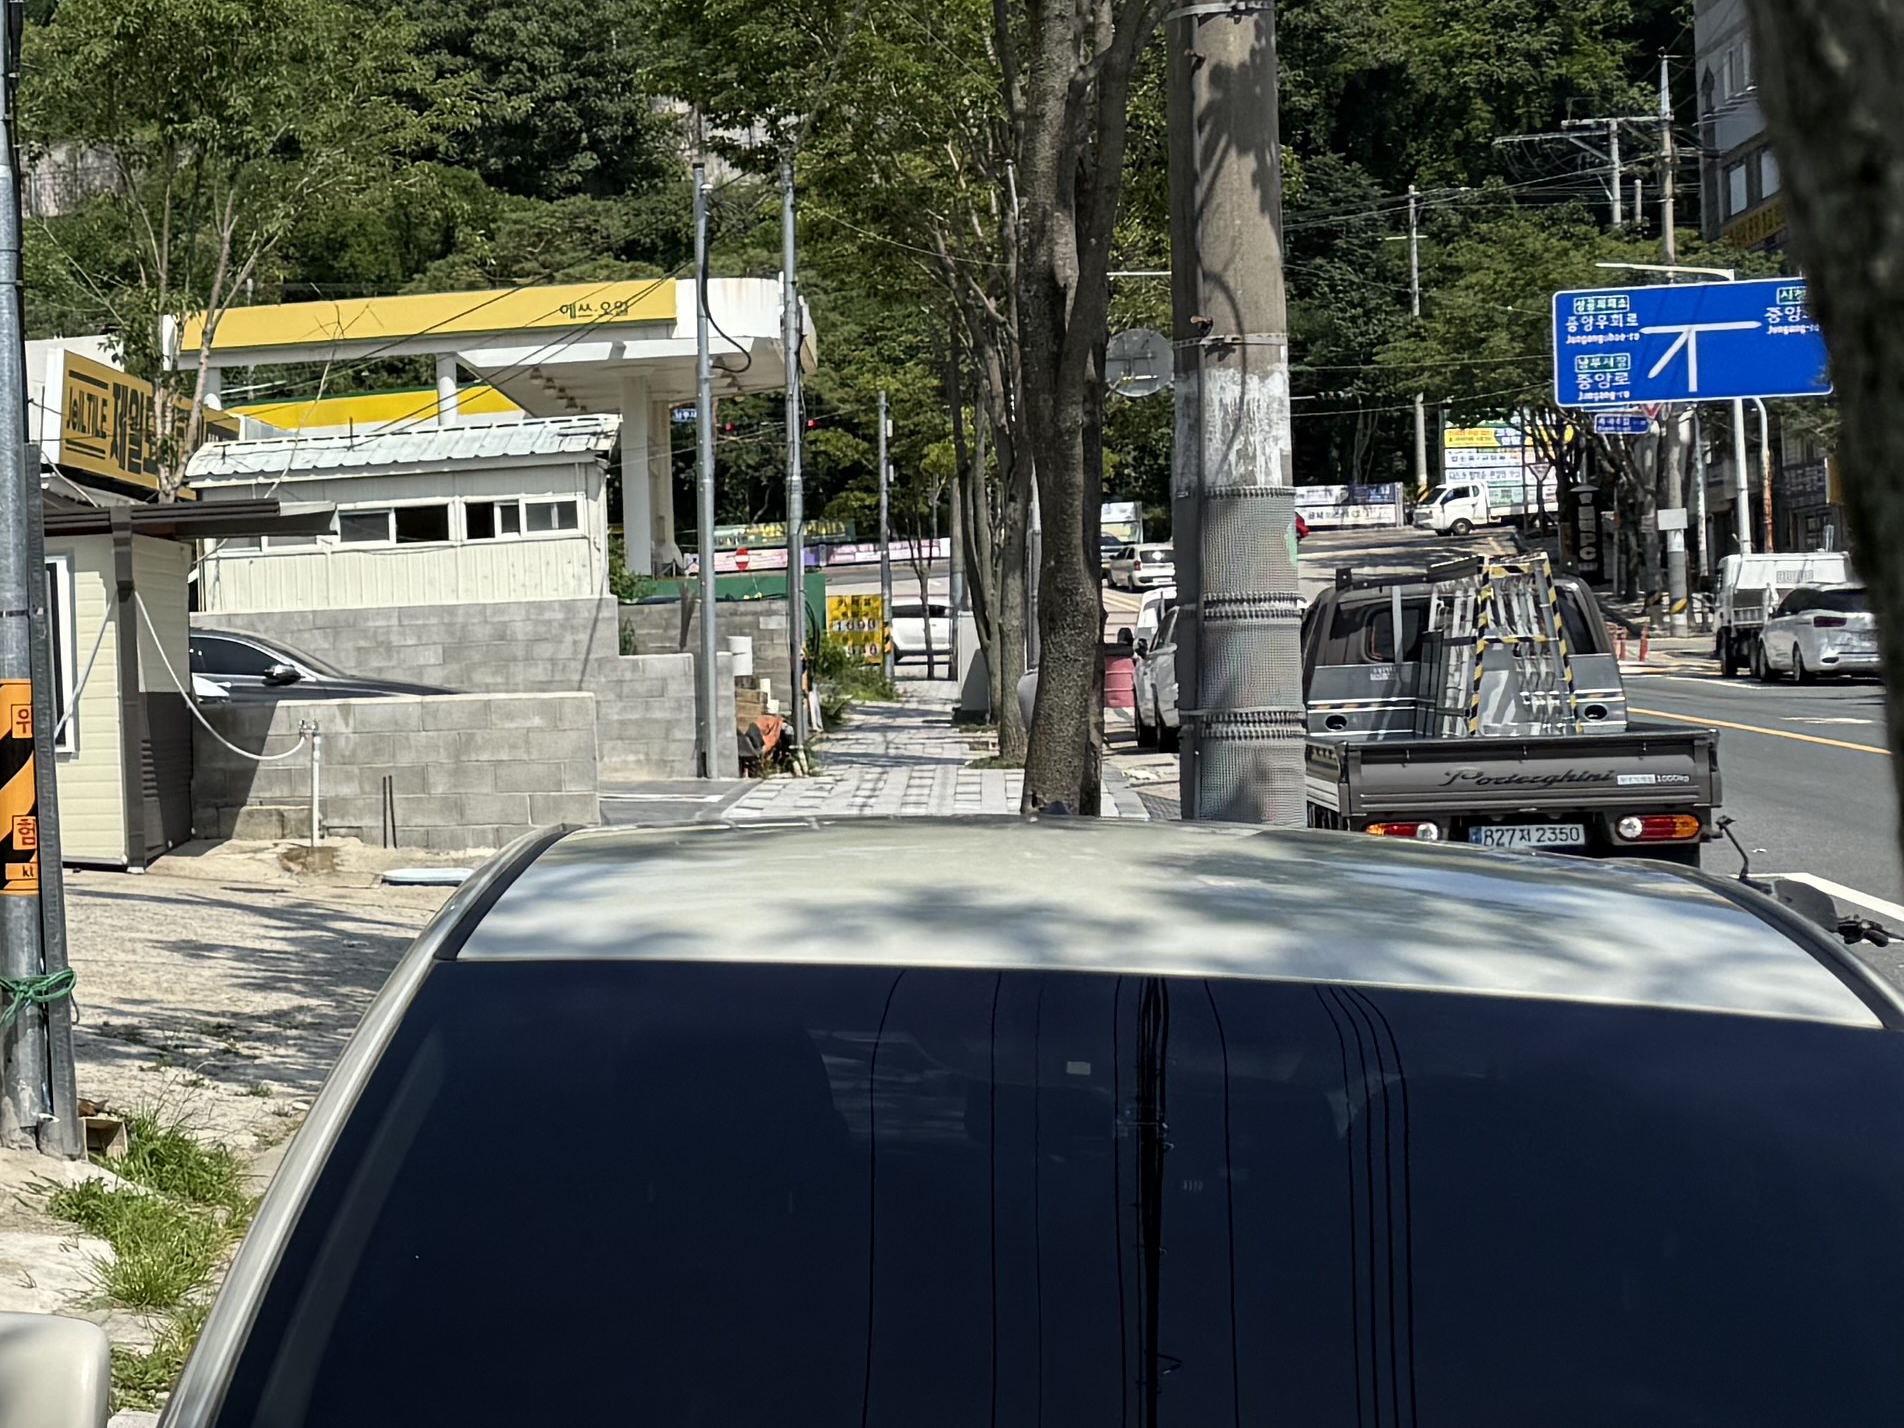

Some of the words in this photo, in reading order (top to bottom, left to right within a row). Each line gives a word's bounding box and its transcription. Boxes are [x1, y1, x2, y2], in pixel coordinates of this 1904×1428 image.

[1566, 313, 1638, 332] 중앙우회로
[1764, 307, 1808, 323] 중앙
[1576, 372, 1631, 390] 중앙로
[1536, 826, 1580, 842] 2350
